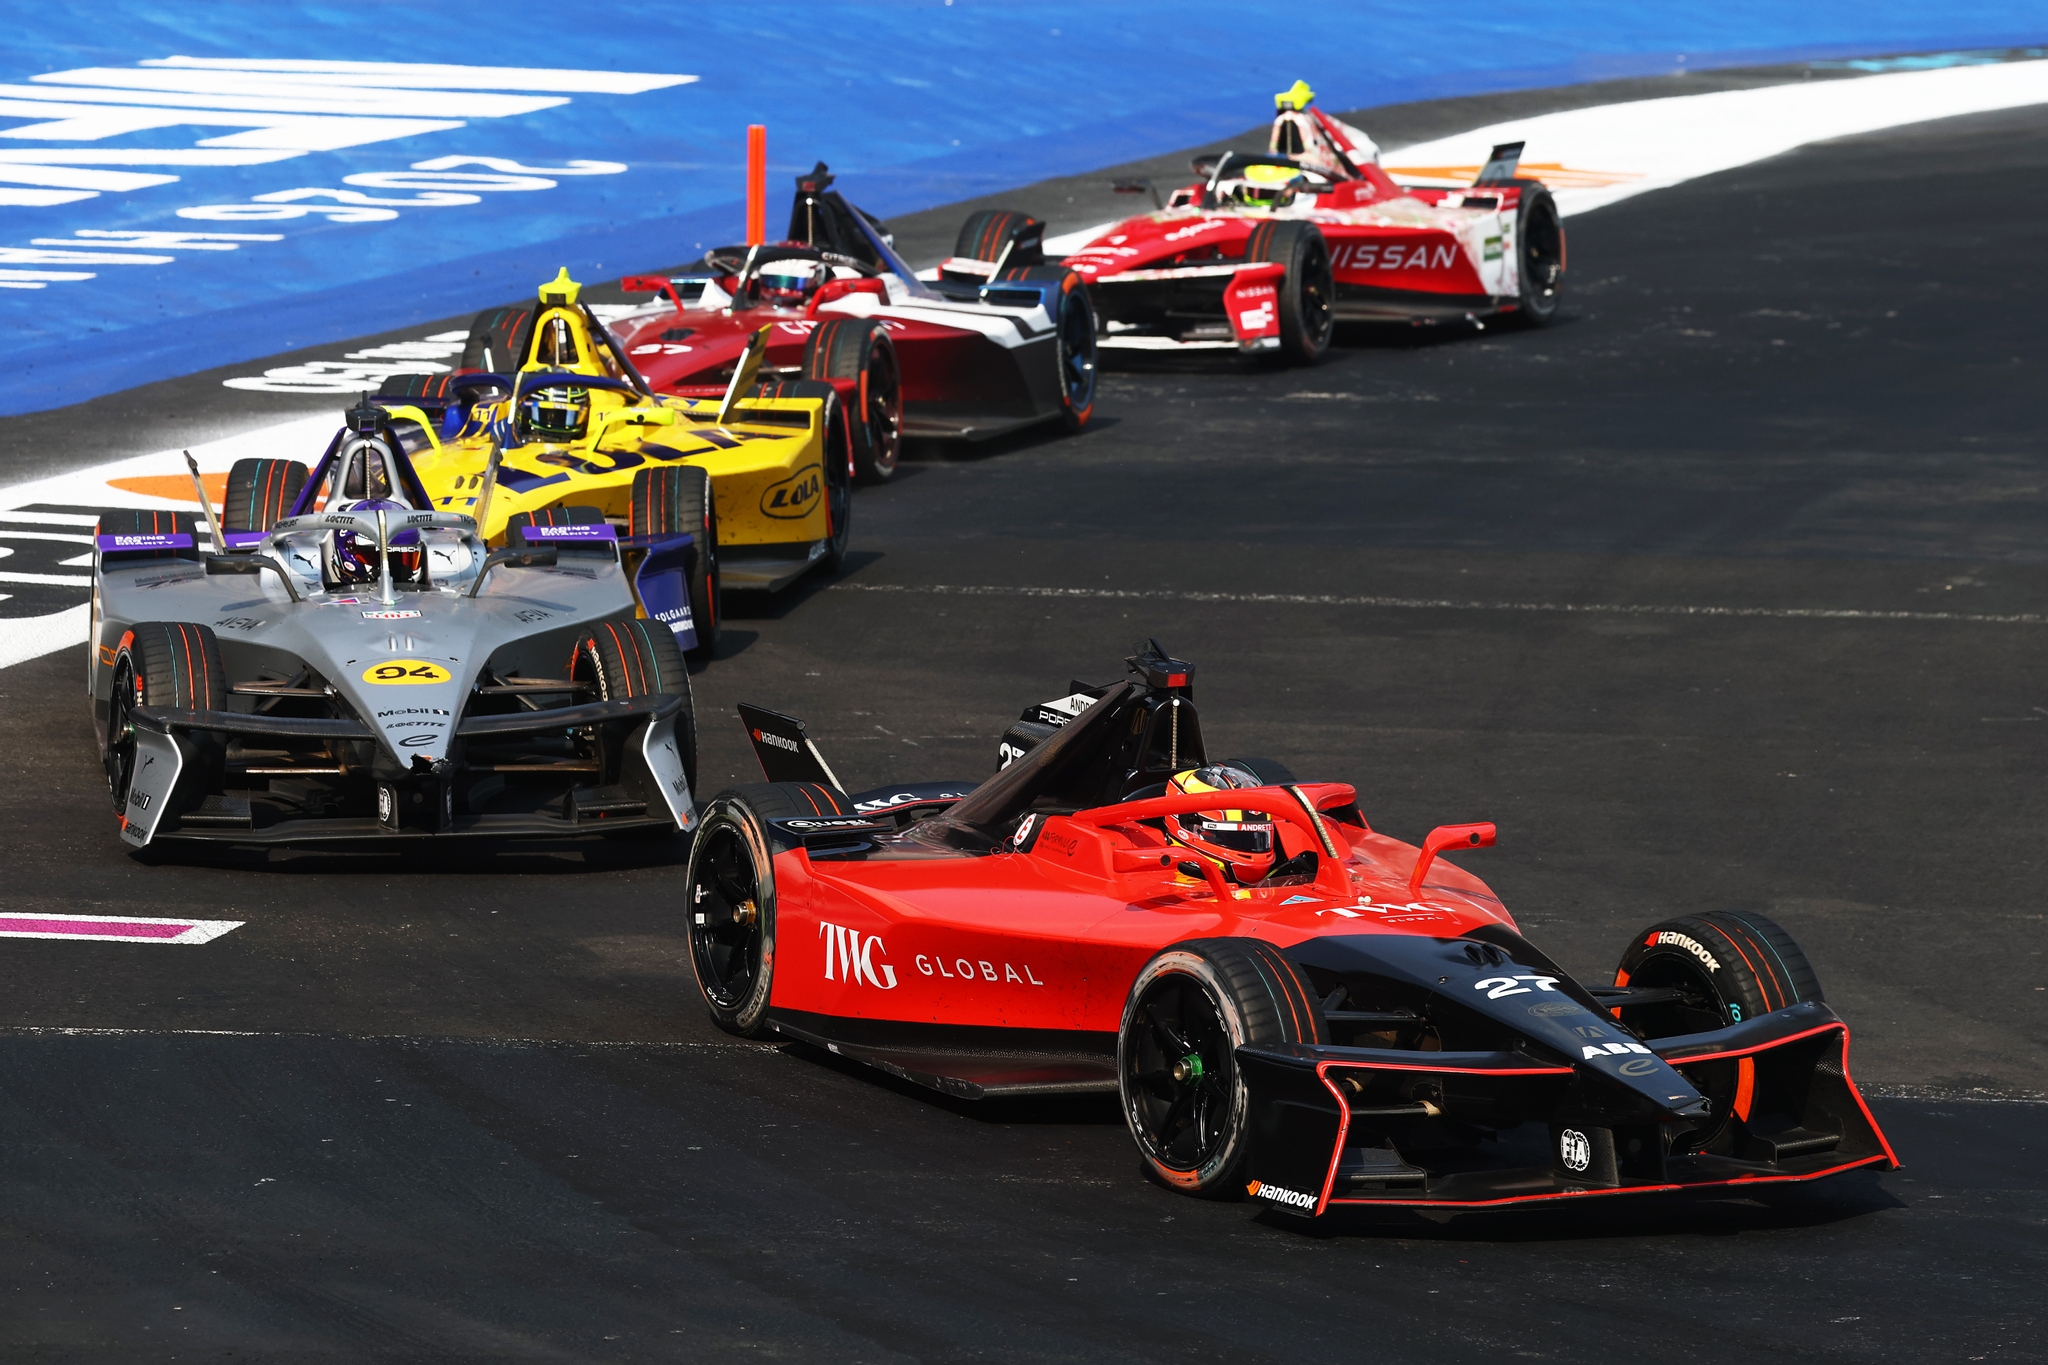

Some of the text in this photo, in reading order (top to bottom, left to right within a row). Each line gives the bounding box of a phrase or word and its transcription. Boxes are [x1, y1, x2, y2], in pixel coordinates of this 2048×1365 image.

[769, 473, 820, 509] LOLA
[325, 514, 356, 525] LOCTITE
[407, 513, 433, 524] LOCTITE
[375, 666, 440, 680] 94
[377, 708, 429, 718] Mobil
[386, 721, 447, 730] LOCTITE
[1387, 916, 1444, 924] GLOBAL
[818, 920, 1044, 990] TWG GLOBAL
[1657, 931, 1722, 974] Hankook
[1474, 975, 1561, 1000] 27
[1581, 1042, 1653, 1061] ABB
[1256, 1183, 1318, 1210] Hankook
